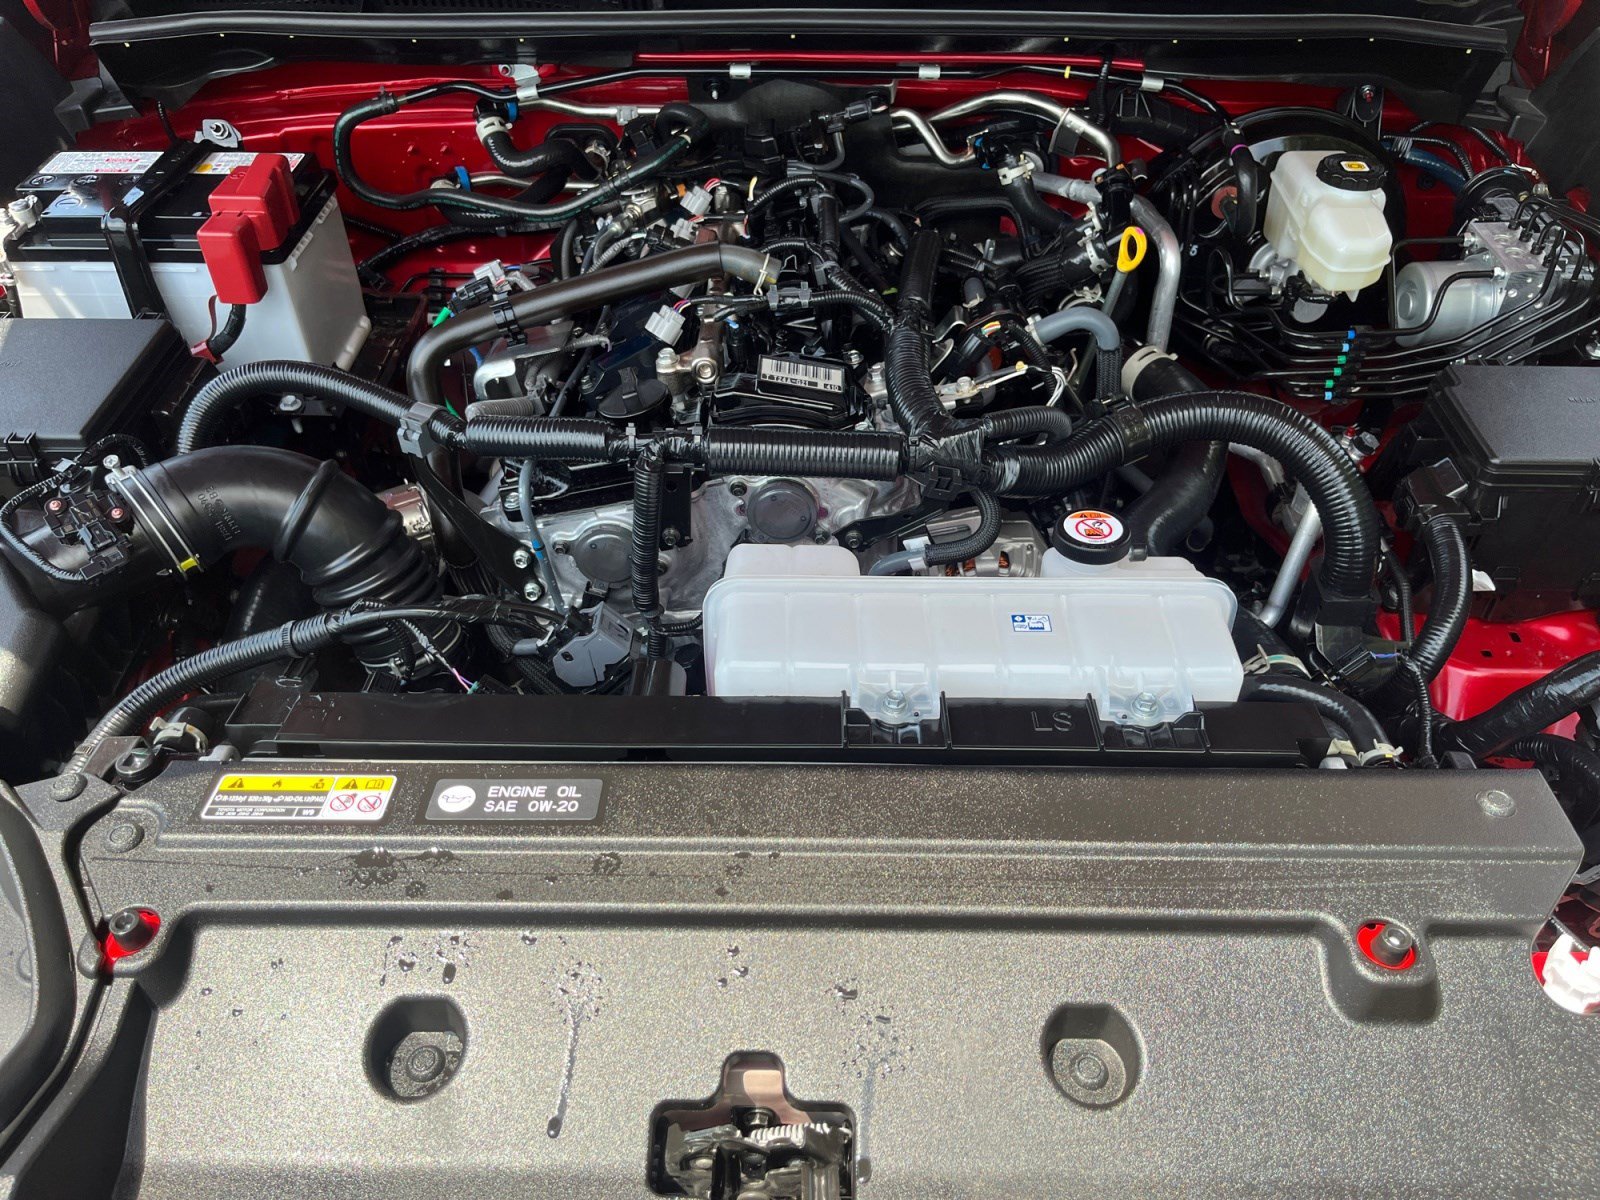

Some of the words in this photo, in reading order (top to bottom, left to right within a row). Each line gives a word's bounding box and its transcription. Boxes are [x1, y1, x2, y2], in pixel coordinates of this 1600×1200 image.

[1031, 710, 1072, 731] LS
[487, 785, 547, 798] ENGINE
[556, 785, 582, 798] OIL
[483, 800, 518, 812] SAE
[527, 800, 579, 813] 0W-20
